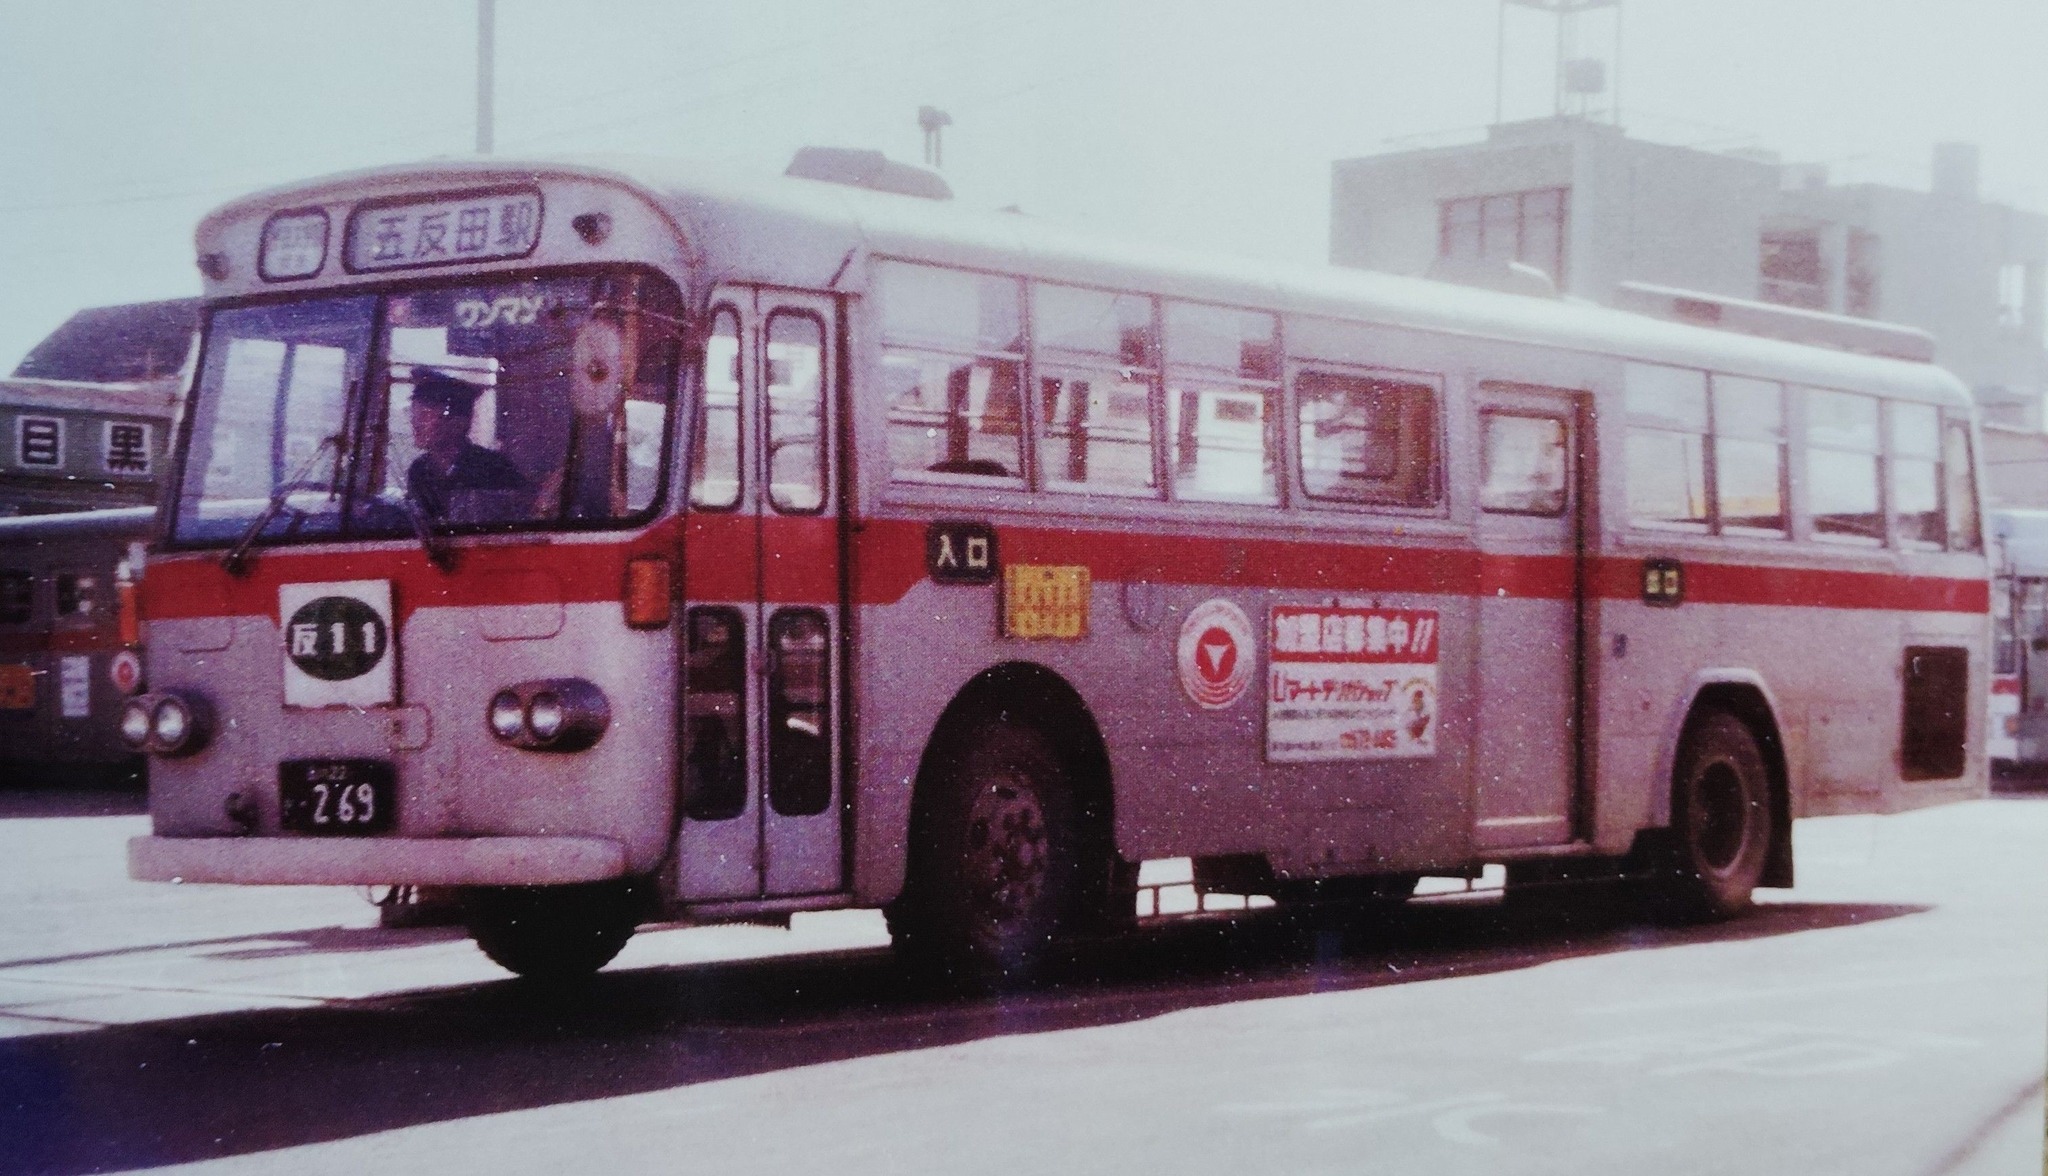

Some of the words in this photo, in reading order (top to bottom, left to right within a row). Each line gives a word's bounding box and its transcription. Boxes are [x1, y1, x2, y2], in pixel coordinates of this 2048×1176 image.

[373, 200, 535, 262] 五反田駅
[454, 296, 545, 328] ワンマン
[22, 419, 149, 471] 目黒
[936, 534, 989, 568] 入口
[292, 622, 377, 656] 反11
